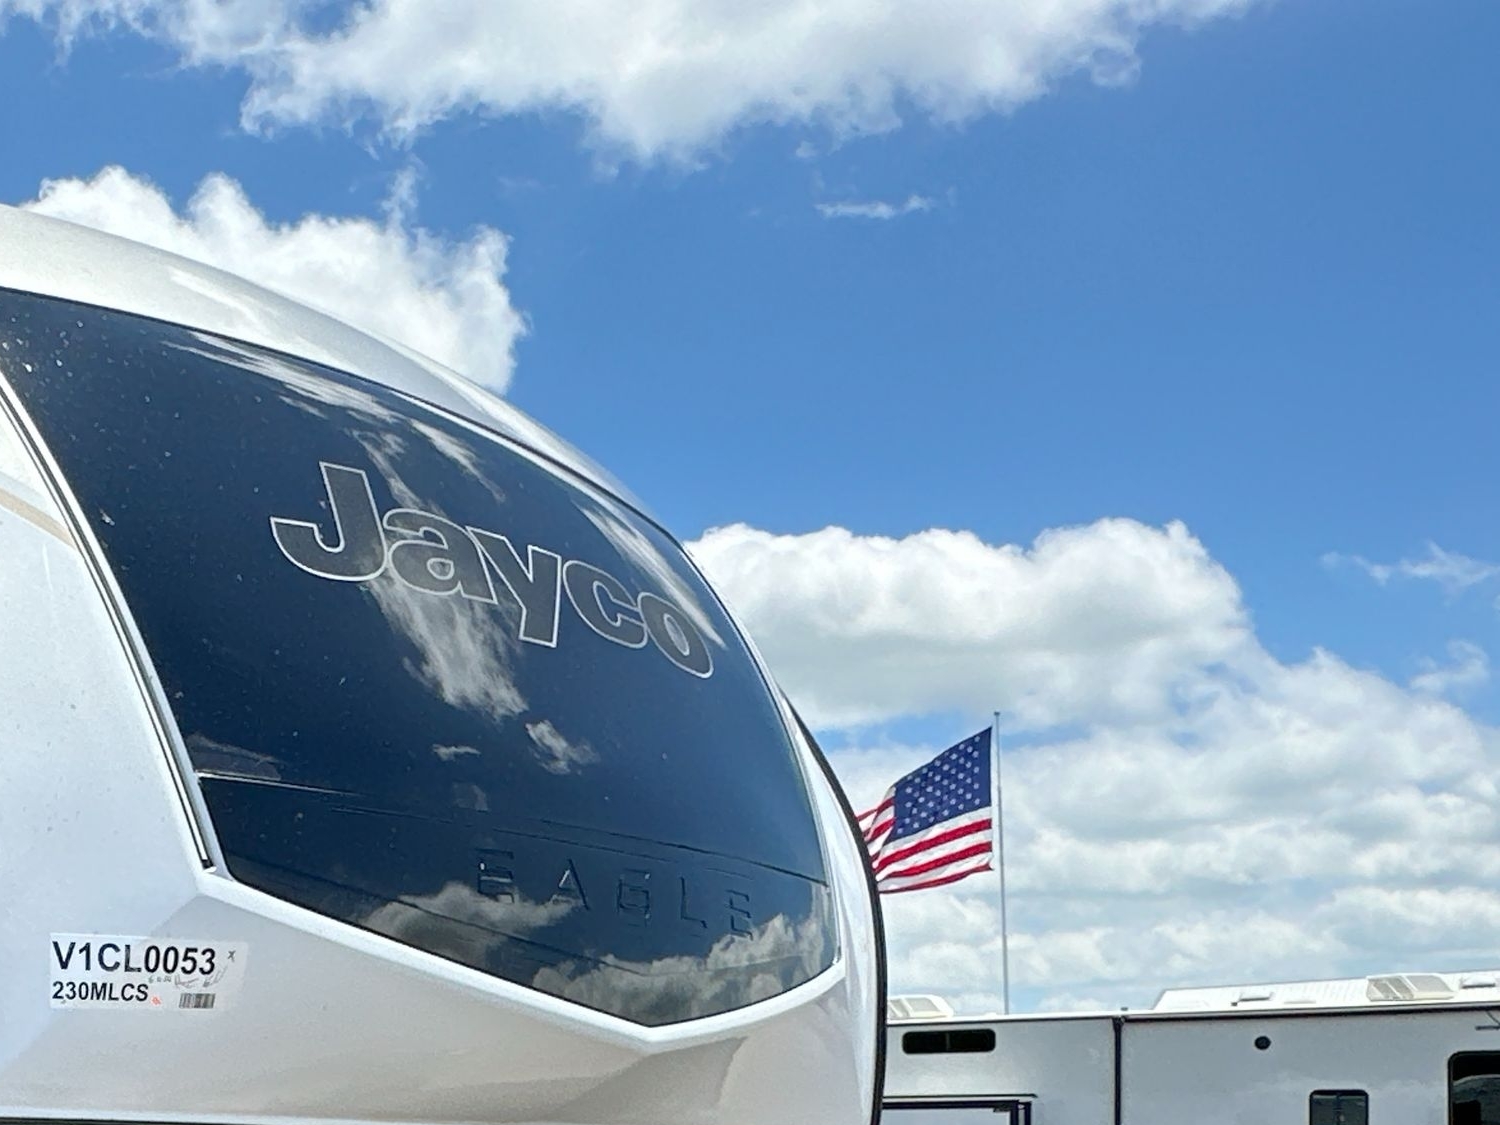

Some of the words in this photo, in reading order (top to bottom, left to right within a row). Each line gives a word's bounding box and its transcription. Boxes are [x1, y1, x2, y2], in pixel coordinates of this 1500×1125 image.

[270, 461, 714, 678] Jayco
[52, 941, 215, 975] V1CL0053
[52, 981, 149, 1001] 230MLCS
